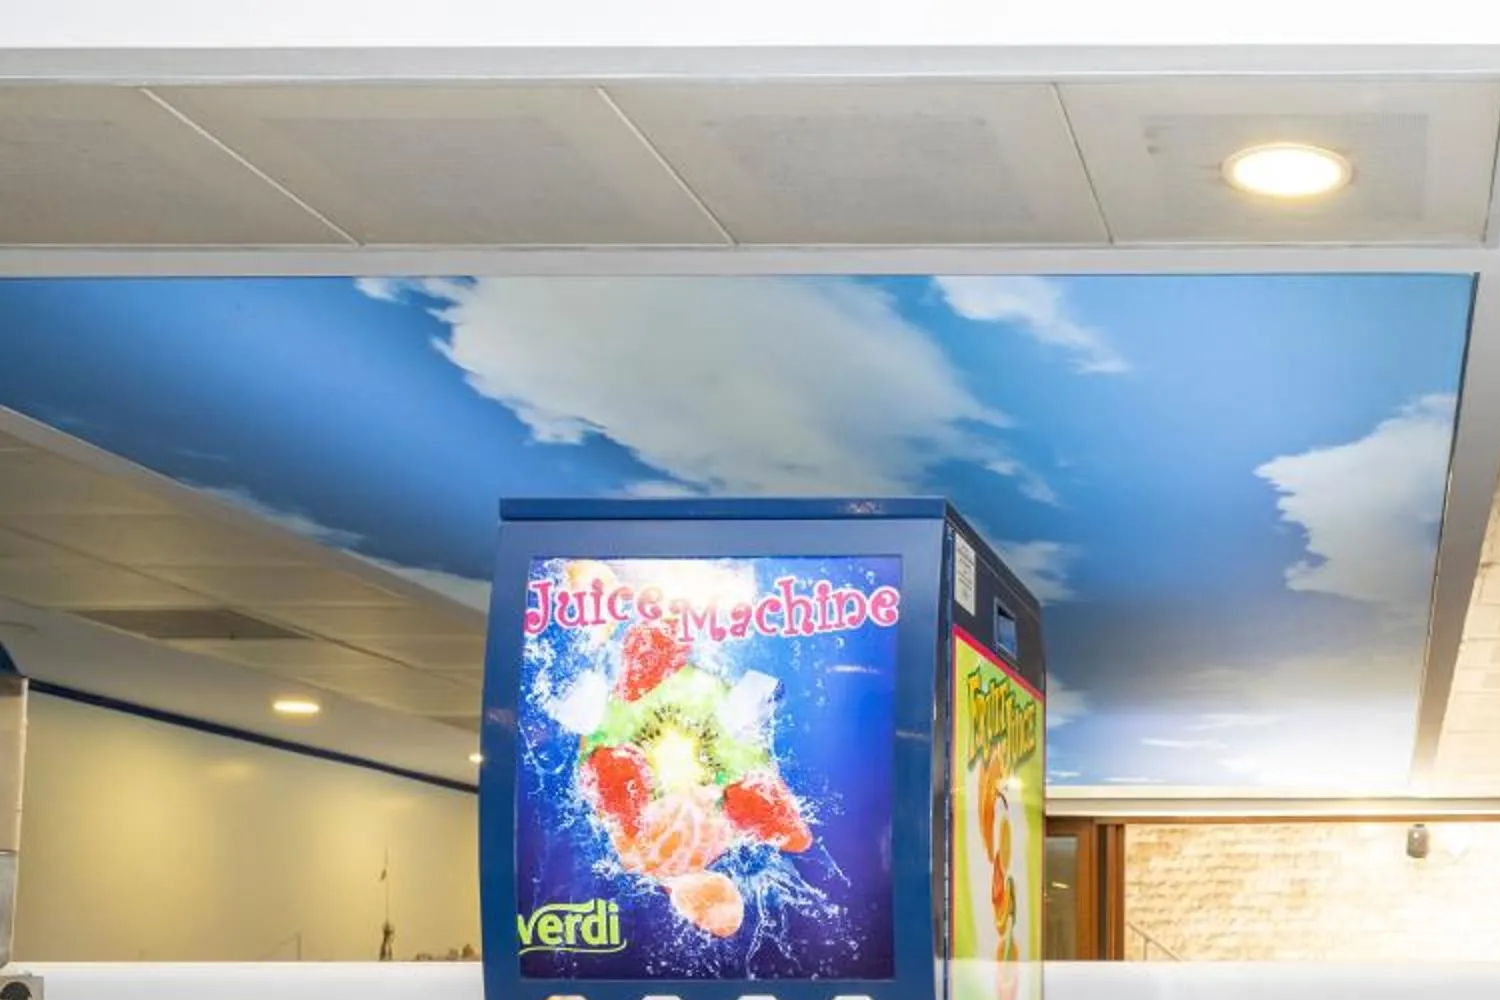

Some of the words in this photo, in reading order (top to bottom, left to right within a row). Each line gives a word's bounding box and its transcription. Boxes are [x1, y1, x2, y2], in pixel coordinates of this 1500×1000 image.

[524, 577, 663, 636] Juice
[670, 575, 900, 643] Machine
[517, 898, 621, 946] verdi
